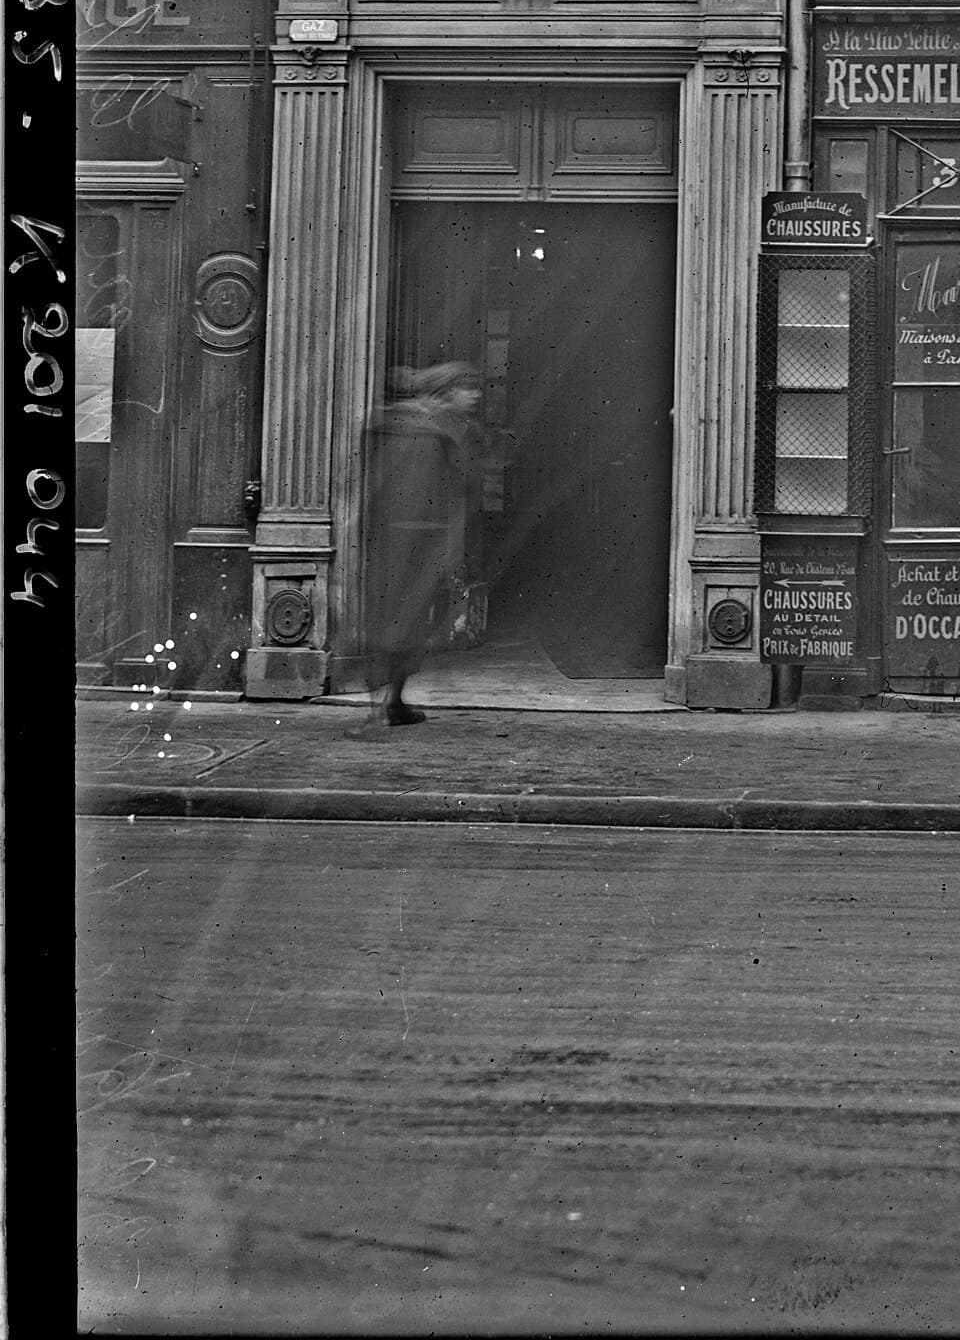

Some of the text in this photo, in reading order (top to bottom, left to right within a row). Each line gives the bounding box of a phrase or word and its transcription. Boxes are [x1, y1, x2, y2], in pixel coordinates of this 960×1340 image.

[772, 196, 853, 217] Manufacture de
[766, 218, 862, 237] CHAUSSURES
[898, 328, 956, 344] Maisons
[890, 563, 941, 588] Achat
[944, 565, 960, 582] et
[763, 588, 853, 610] CHAUSSURES
[901, 589, 922, 606] de
[773, 613, 841, 622] AU DETAIL
[762, 637, 789, 658] PRIX
[799, 638, 854, 659] FABRIQUE
